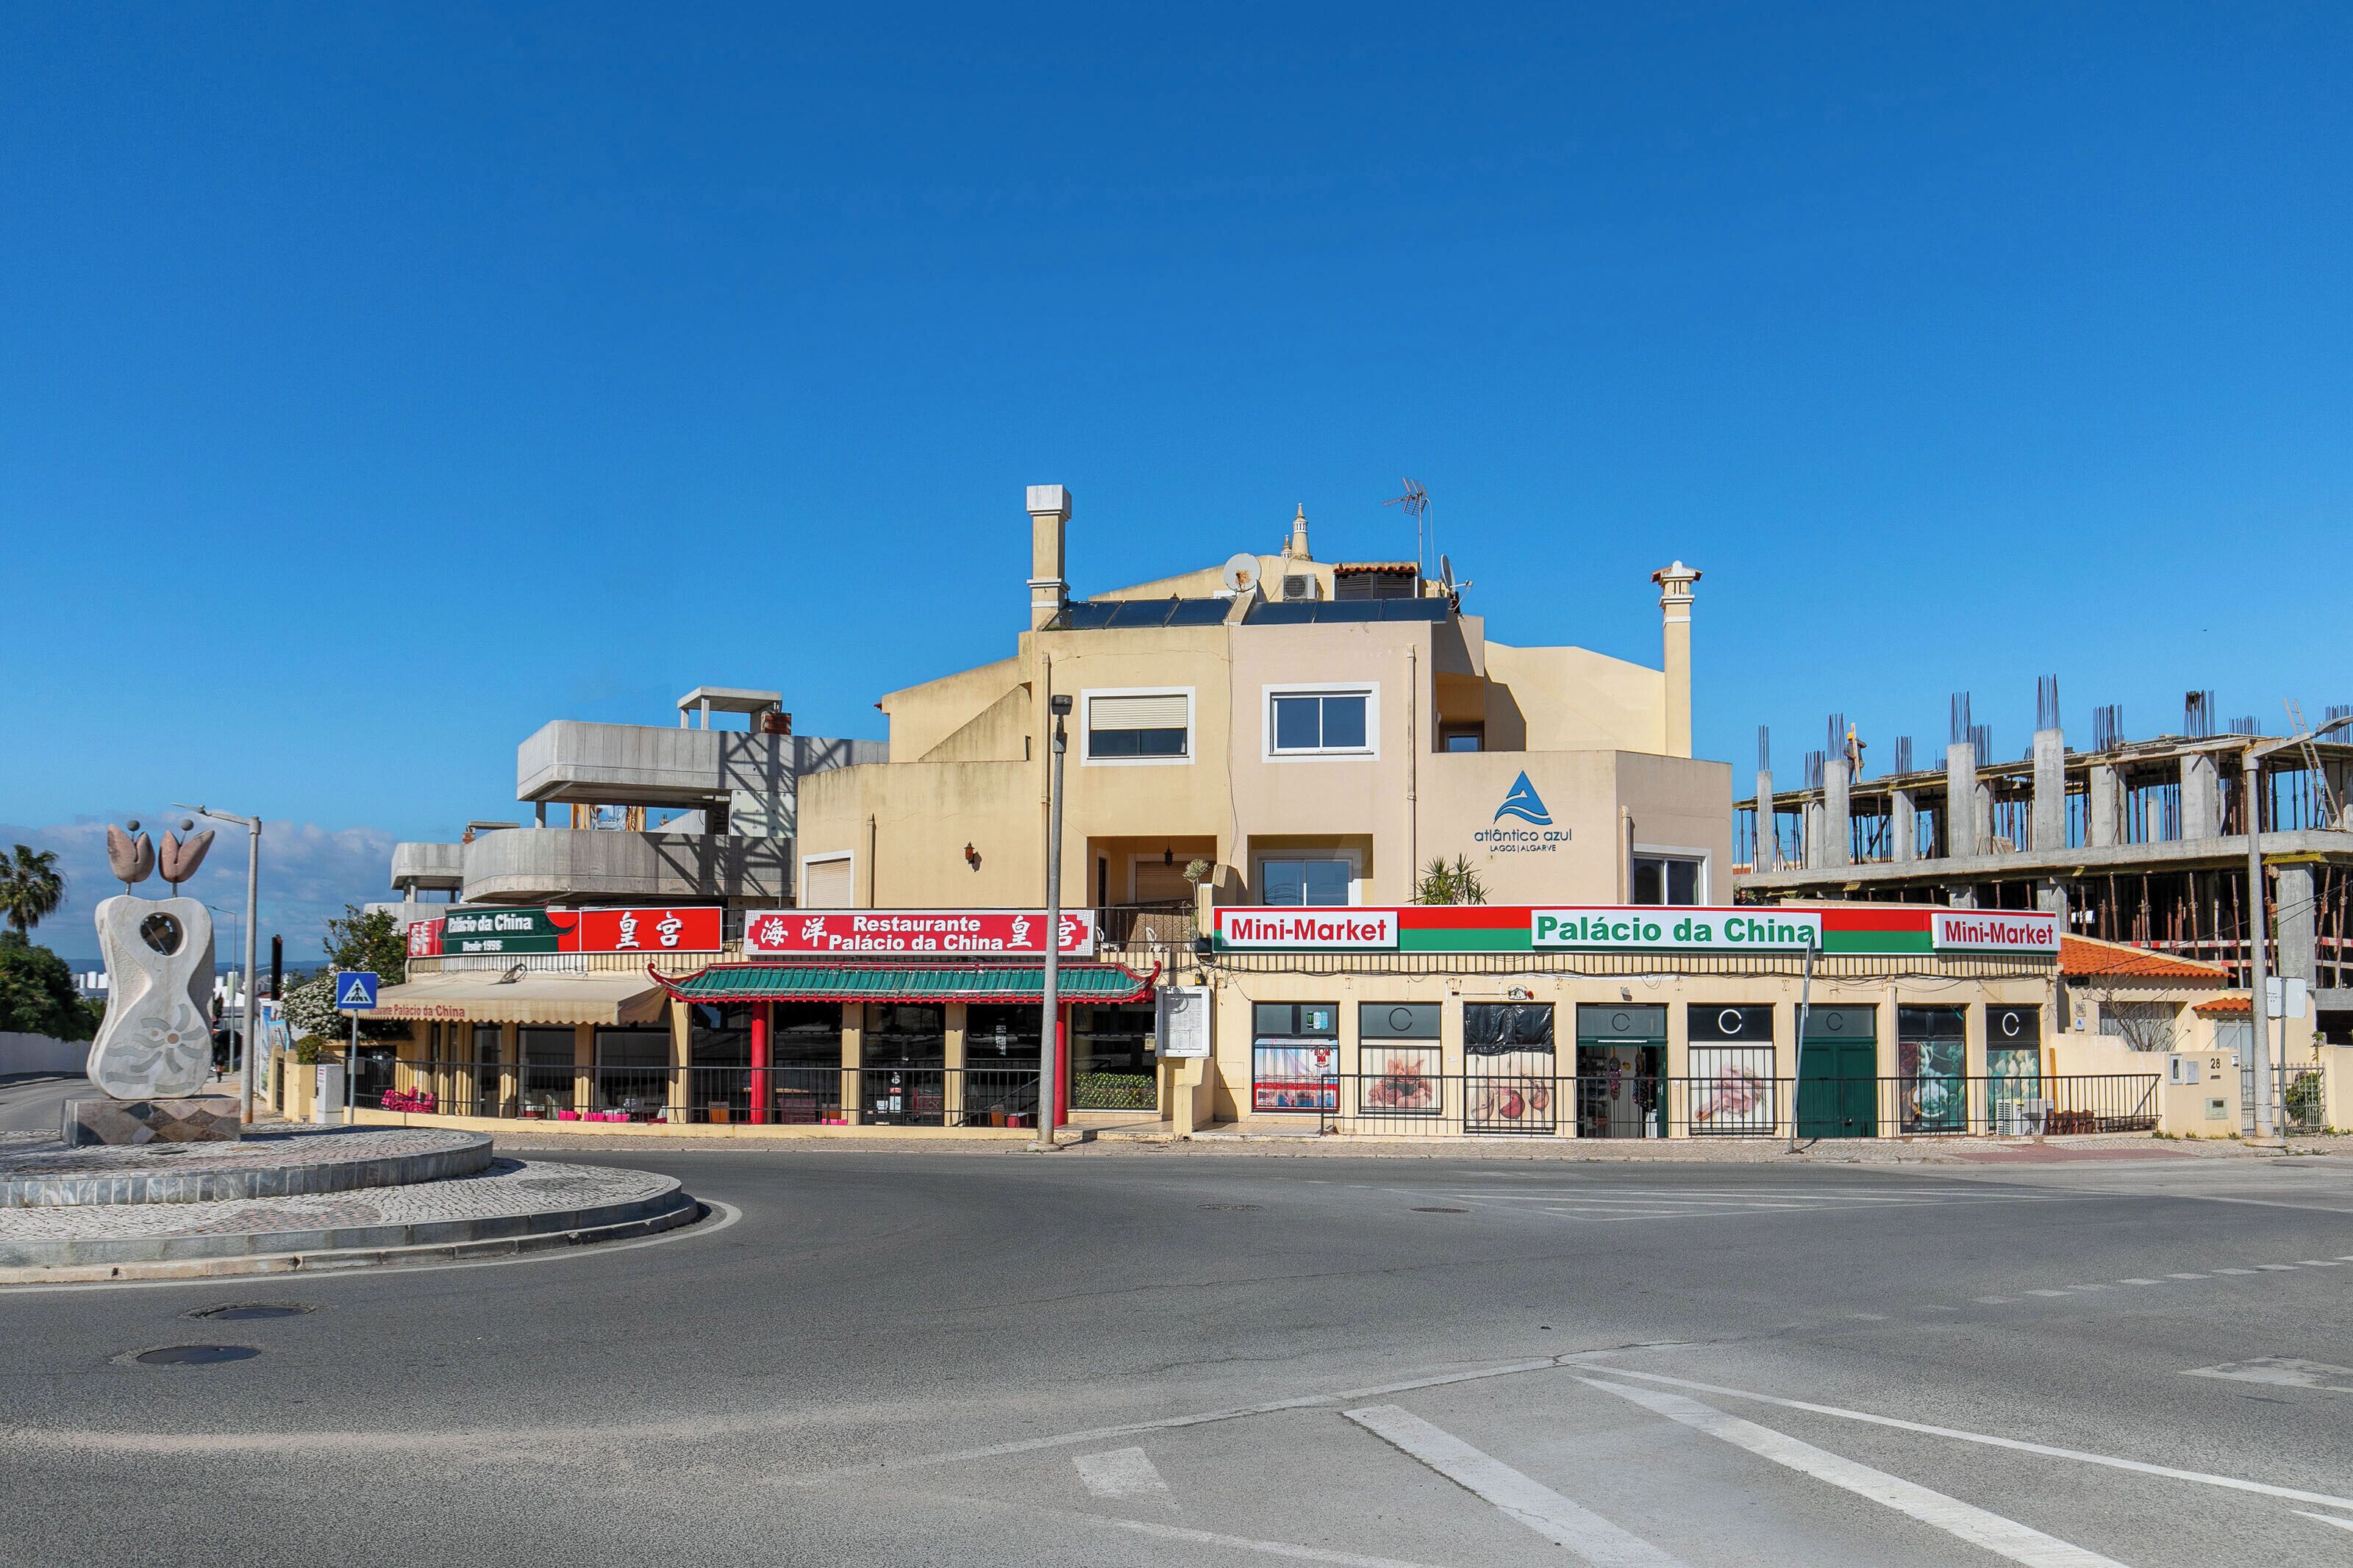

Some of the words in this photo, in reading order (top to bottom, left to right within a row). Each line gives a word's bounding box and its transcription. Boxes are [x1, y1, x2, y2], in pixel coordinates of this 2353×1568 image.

[1474, 828, 1539, 842] atlântico
[1543, 828, 1572, 842] azul
[478, 915, 493, 931] da
[494, 914, 534, 931] China
[853, 916, 981, 932] Restaurante
[1232, 918, 1387, 941] Mini-Market
[1537, 916, 1662, 942] Palácio
[1673, 917, 1713, 942] da
[1724, 917, 1815, 942] China
[1945, 920, 2054, 945] Mini-Market
[829, 934, 905, 951] Palácio
[911, 934, 936, 951] da
[943, 934, 1003, 951] China
[393, 1004, 421, 1016] Palácio
[423, 1005, 433, 1017] da
[435, 1004, 465, 1017] China
[2210, 1058, 2221, 1069] 28
